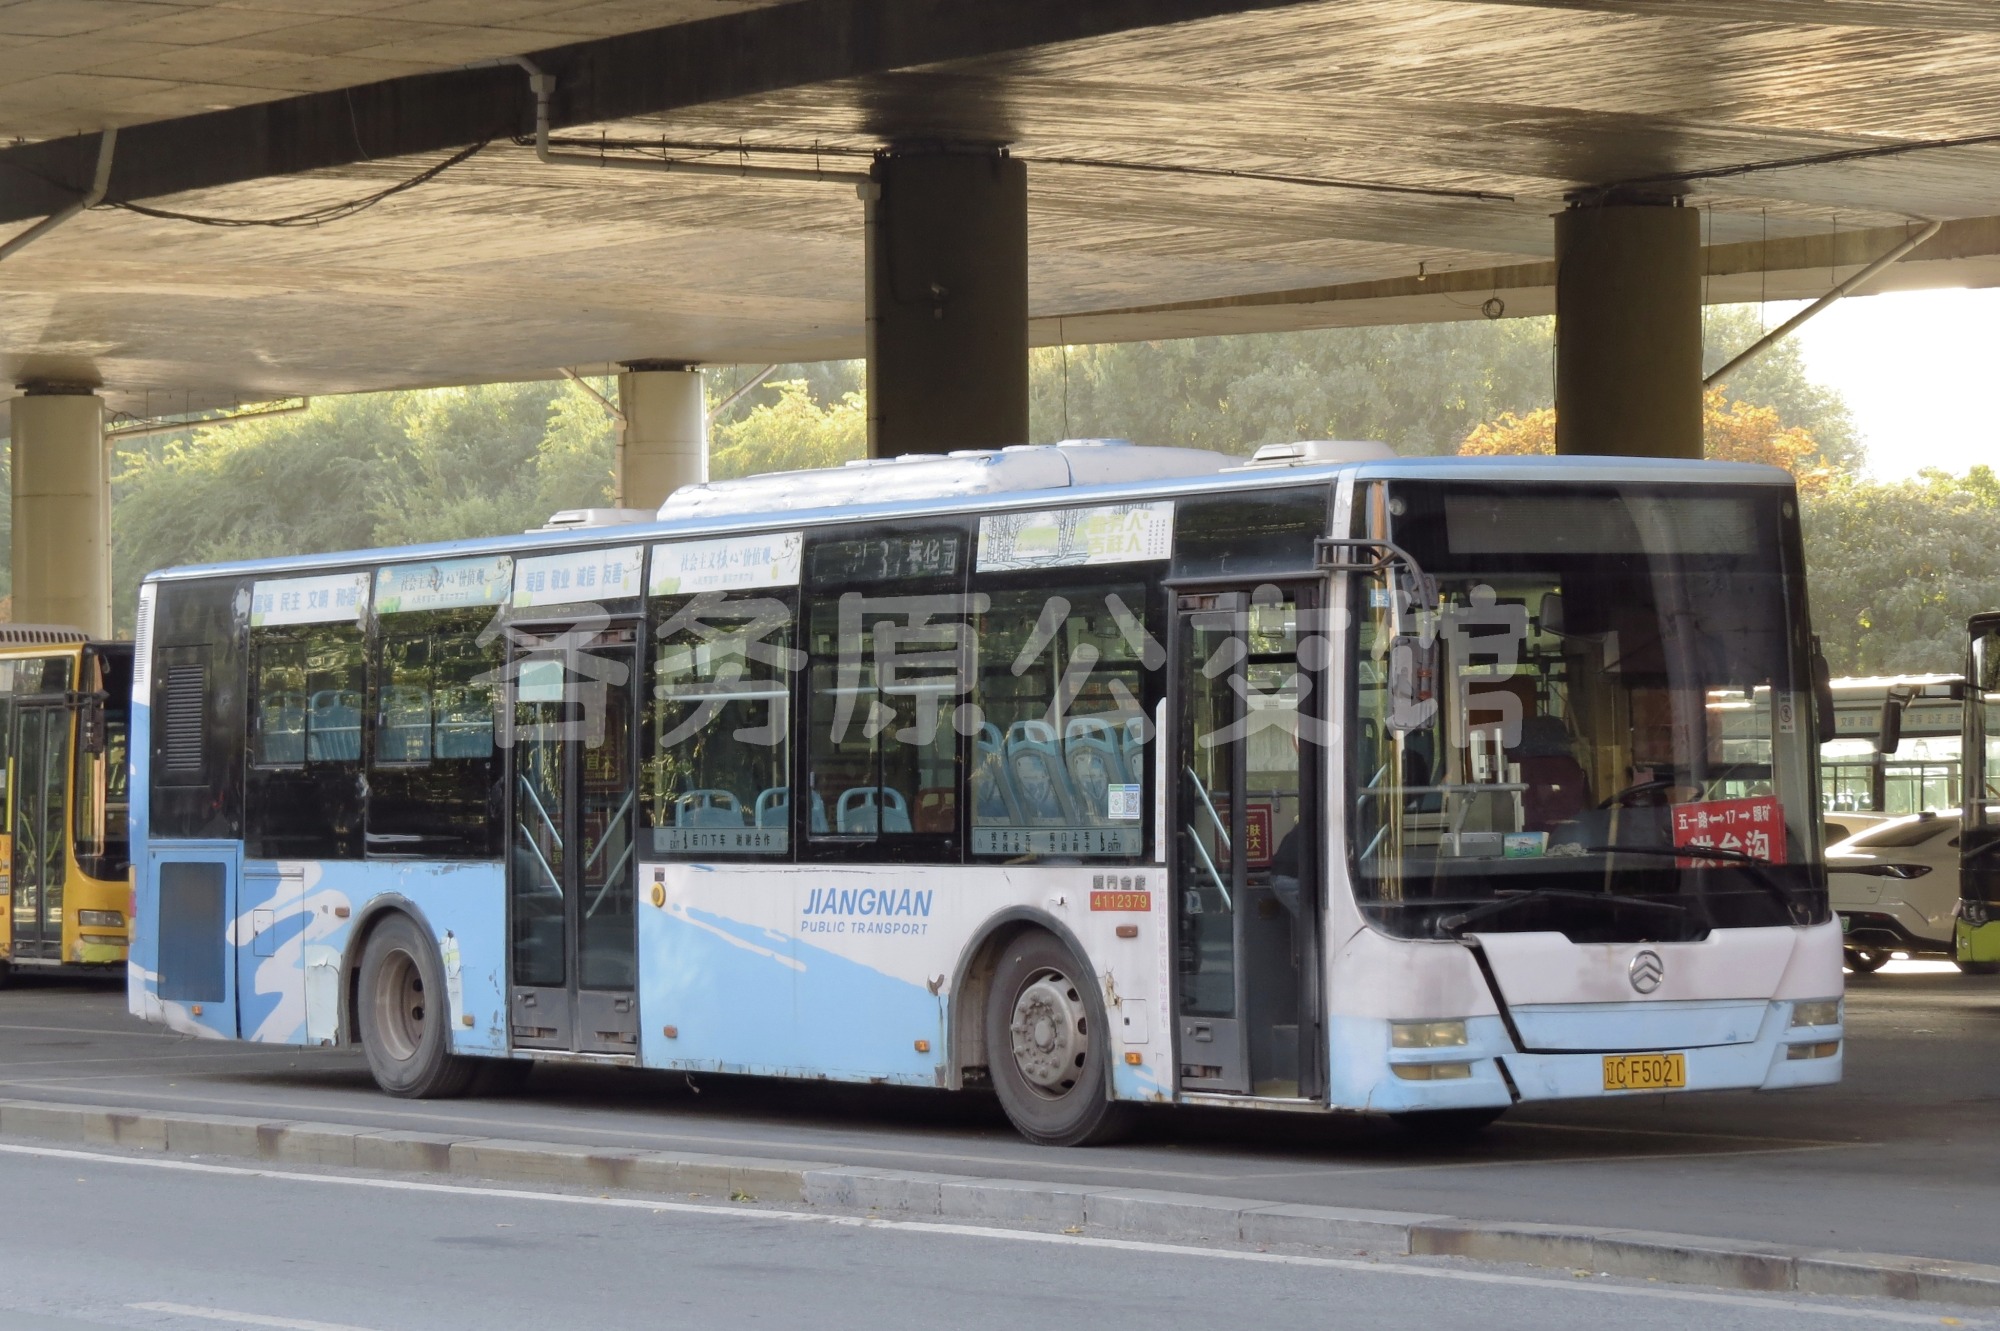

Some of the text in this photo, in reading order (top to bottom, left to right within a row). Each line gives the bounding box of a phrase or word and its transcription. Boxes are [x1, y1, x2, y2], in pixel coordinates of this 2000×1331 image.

[526, 562, 623, 592] 爱国 敬业 诚信 友善
[280, 591, 301, 611] 民主
[307, 589, 329, 609] 文明
[1678, 810, 1709, 830] 五一路
[1725, 809, 1736, 824] 17
[692, 834, 725, 847] 后门下车
[802, 887, 933, 917] JIANGNAN
[1094, 894, 1148, 909] 4112379
[801, 920, 928, 935] PUBLIC TRANSPORT
